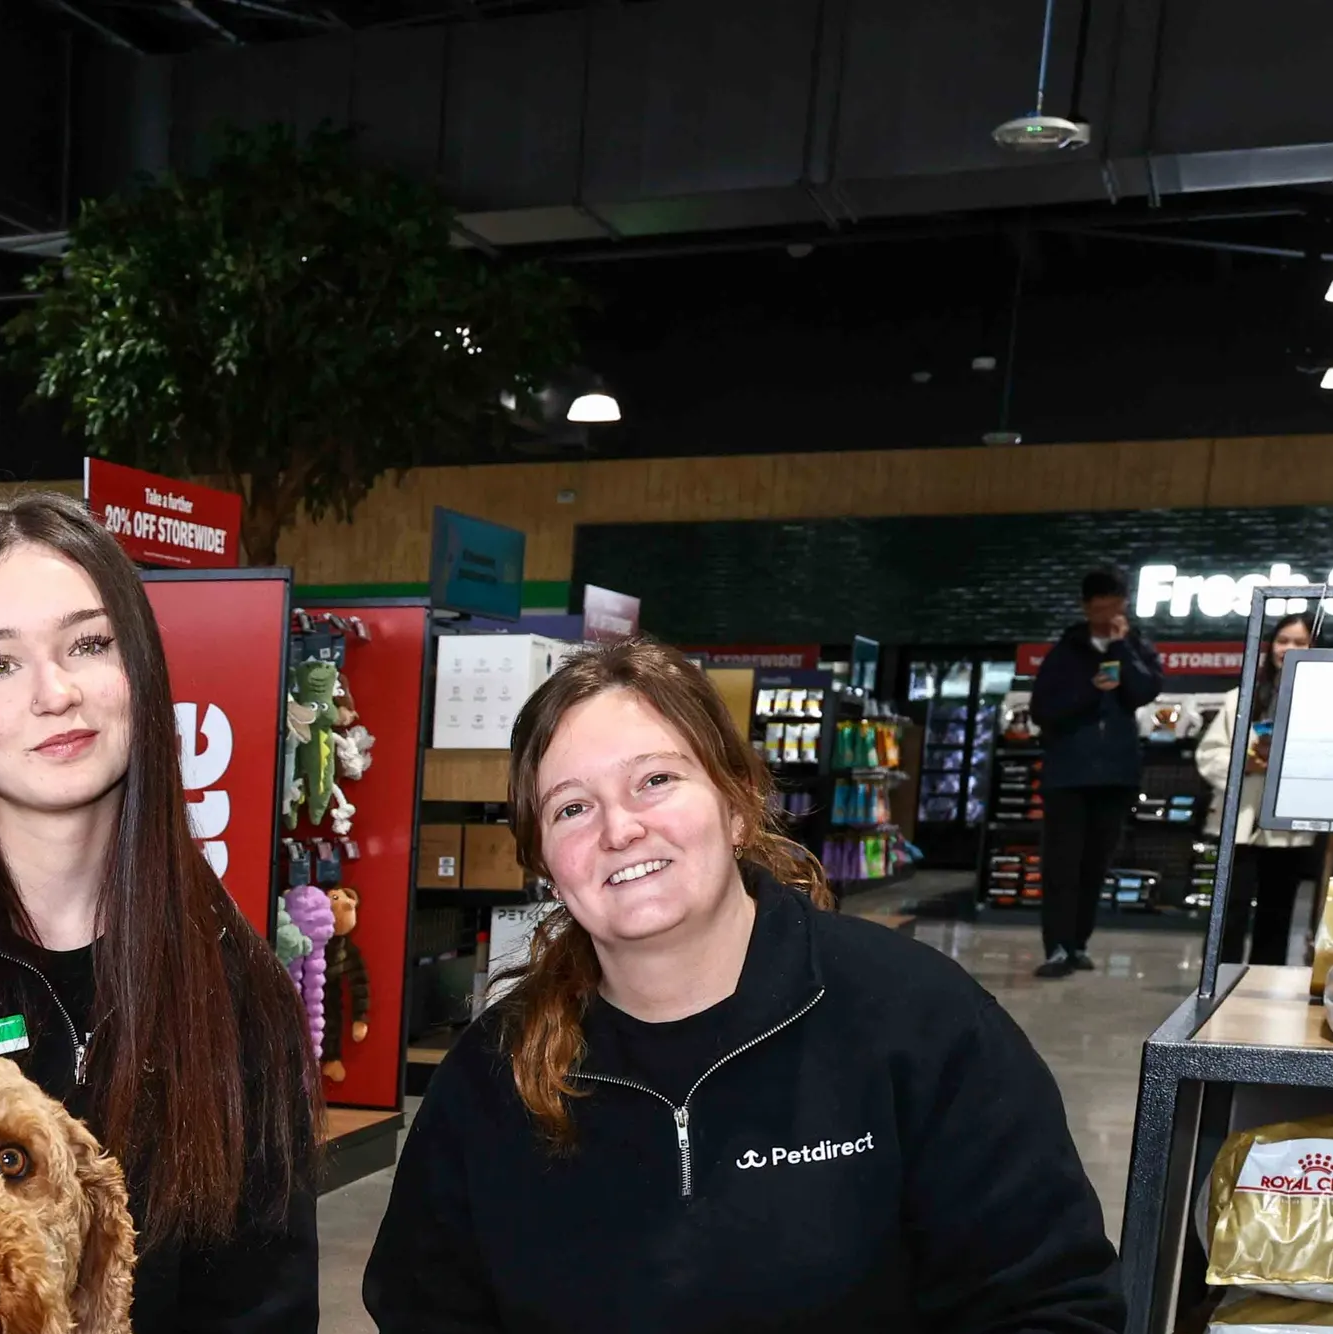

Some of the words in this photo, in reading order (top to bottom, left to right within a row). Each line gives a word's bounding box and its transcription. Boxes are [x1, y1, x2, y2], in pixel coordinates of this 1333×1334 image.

[144, 487, 162, 507] Take
[163, 495, 168, 508] a
[168, 492, 193, 514] further
[105, 504, 131, 535] 20%
[134, 511, 157, 540] OFF
[158, 516, 227, 554] STOREWIDE!
[771, 1132, 875, 1166] Petdirect
[1261, 1175, 1313, 1191] ROYAL
